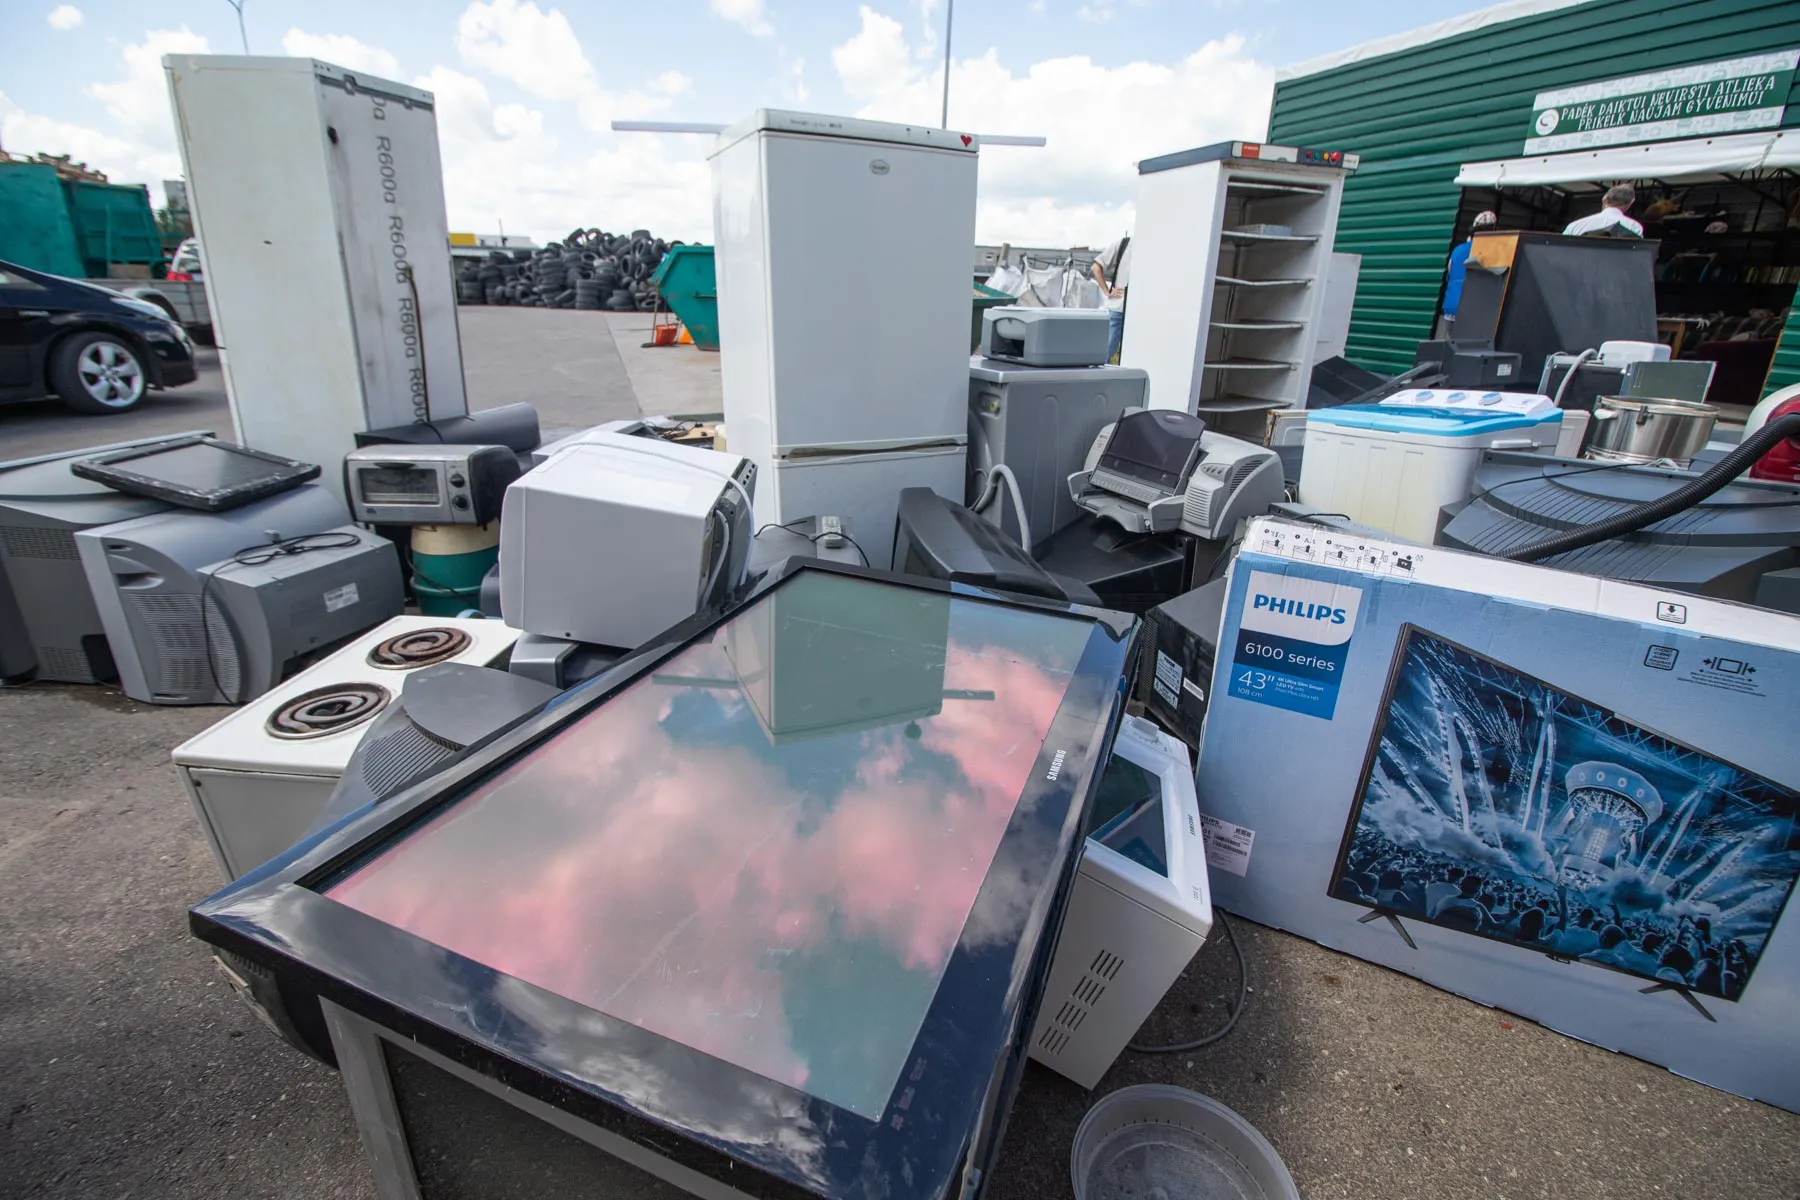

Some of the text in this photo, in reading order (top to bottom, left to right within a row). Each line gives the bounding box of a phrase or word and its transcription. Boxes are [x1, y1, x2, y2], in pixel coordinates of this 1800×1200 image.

[1578, 92, 1764, 131] PRIKELK NAUJAM GYVENIMUI
[1600, 96, 1646, 115] DAIKTUI
[1650, 84, 1709, 107] NEVIRSTI
[1715, 75, 1775, 93] ATLIEKA
[376, 136, 396, 203] R600a
[398, 298, 417, 358] R600a
[1254, 594, 1346, 624] PHILIPS
[1245, 642, 1335, 671] 6100 series
[1046, 750, 1067, 781] SAMSUNG
